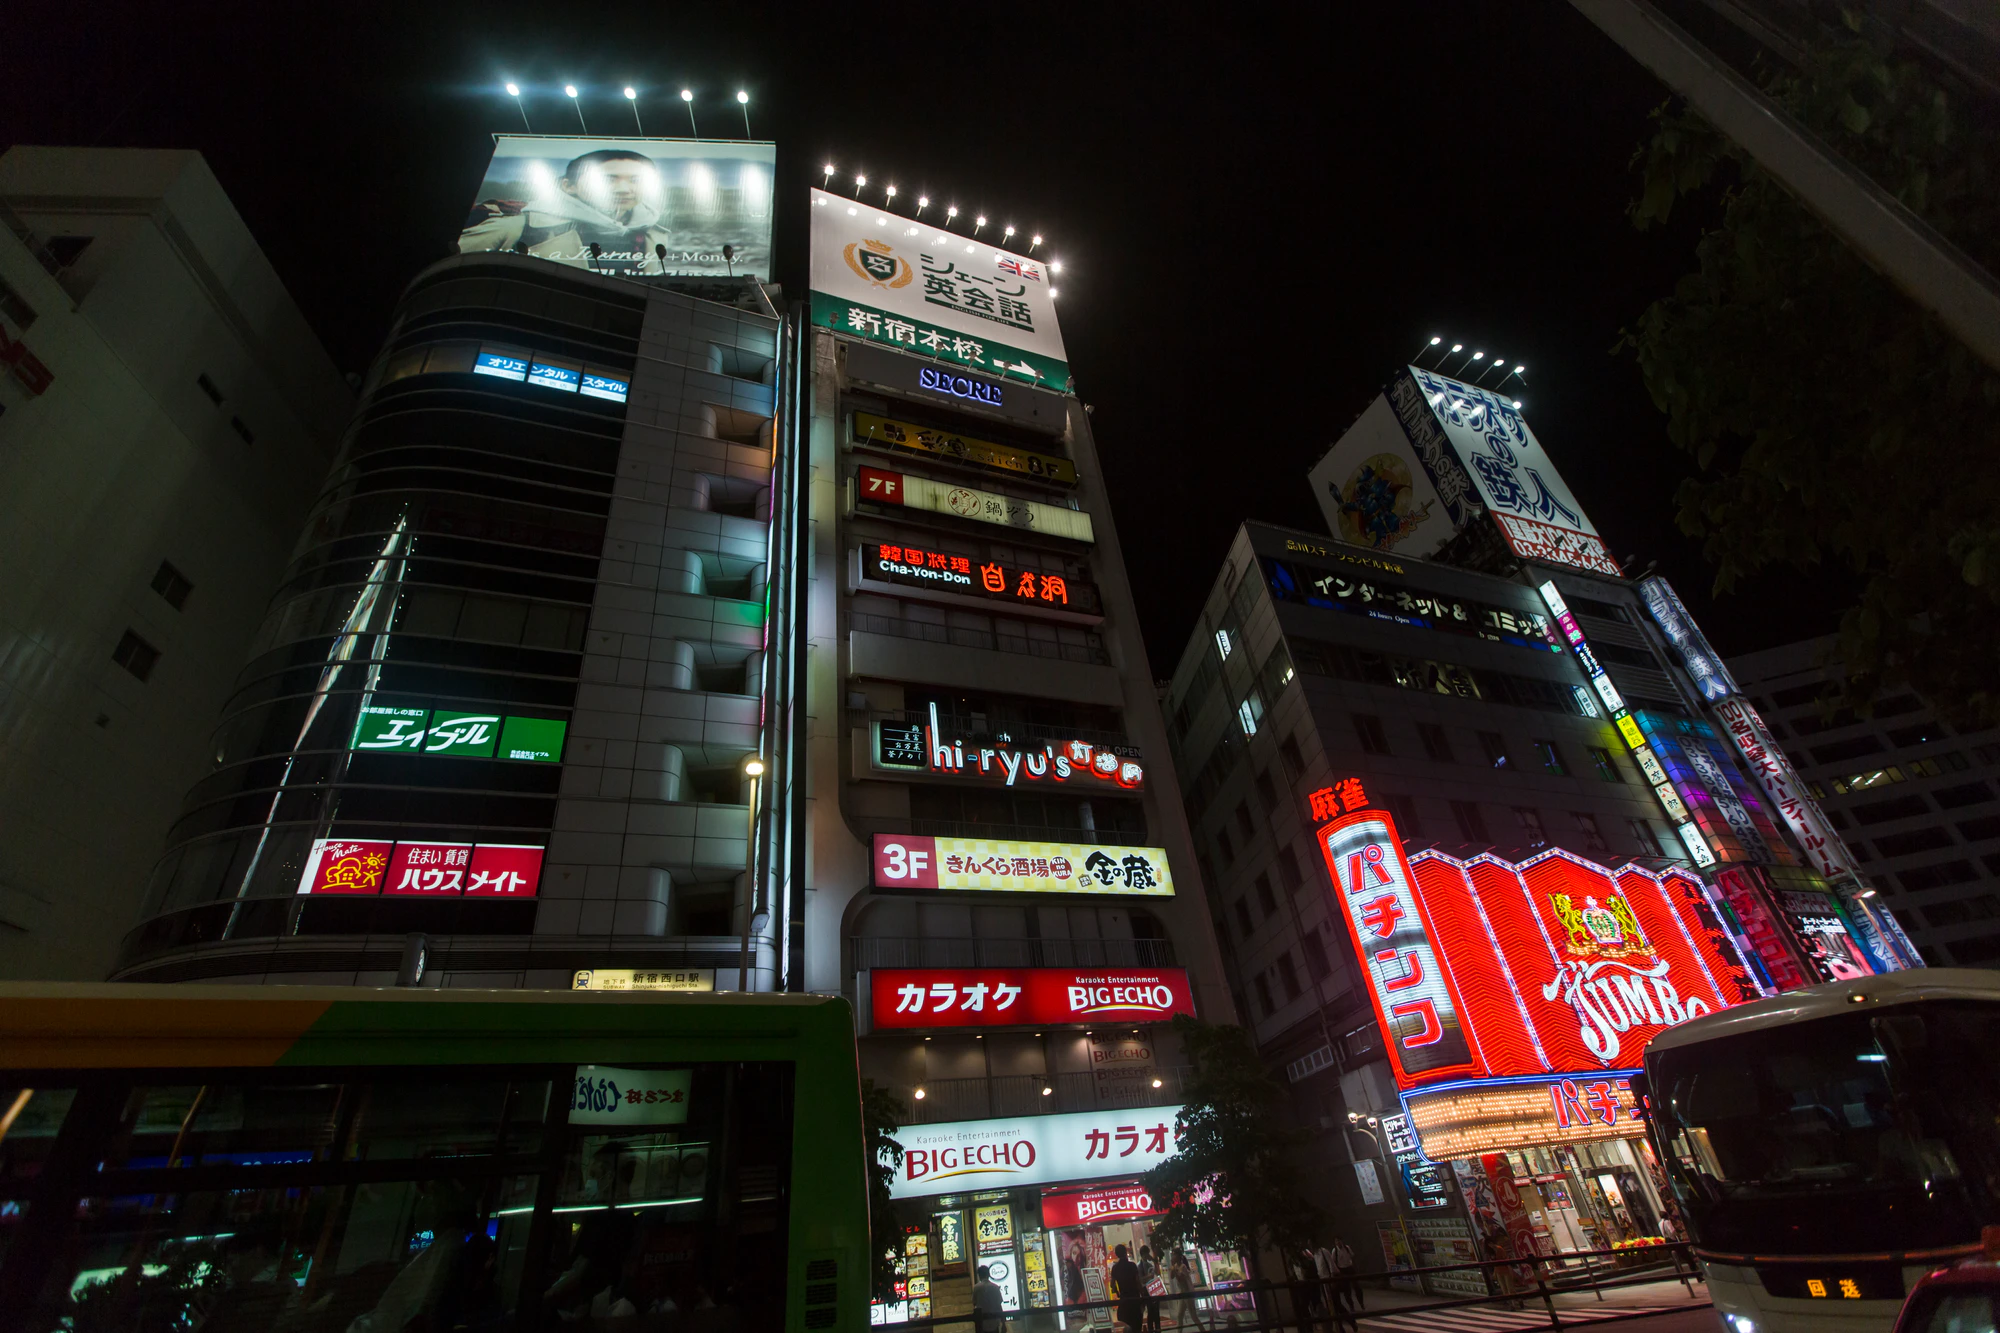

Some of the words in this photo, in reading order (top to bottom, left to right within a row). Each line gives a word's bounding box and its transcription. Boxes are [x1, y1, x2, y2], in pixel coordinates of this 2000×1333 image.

[920, 253, 1026, 297] シェーン
[923, 273, 1032, 325] 英会話
[848, 307, 986, 365] 新宿本校
[919, 367, 1003, 406] SECRE
[868, 477, 896, 495] 7F
[984, 500, 1034, 523] 鍋ぞう
[879, 543, 971, 574] 韓国料理
[879, 559, 971, 586] Cha-Yon-Don
[1615, 711, 1627, 720] 4F
[358, 716, 499, 751] エイブル
[929, 701, 1071, 786] hi-ryu's
[1307, 776, 1370, 823] 麻雀
[1716, 700, 1847, 880] 100名収容大パーティールーム
[331, 844, 363, 861] Mate
[407, 848, 441, 865] 住まい
[444, 849, 469, 866] 賃貸
[882, 843, 928, 879] 3F
[1051, 857, 1066, 865] KIN
[945, 854, 1050, 878] きんくら酒場
[1085, 850, 1156, 890] 金の蔵
[397, 868, 527, 892] ハウスメイト
[1347, 843, 1444, 1049] パチンコ
[632, 972, 699, 984] 新宿西口駅
[1075, 976, 1105, 984] Karaoke
[1107, 975, 1159, 984] Entertainment
[896, 982, 1021, 1013] カラオケ
[1068, 986, 1111, 1011] BIG
[1114, 985, 1173, 1009] ECHO
[1093, 1050, 1116, 1063] BIG
[1118, 1048, 1150, 1060] ECHO
[916, 1136, 954, 1144] Karaoke
[957, 1128, 1021, 1141] Entertainment
[1085, 1122, 1188, 1161] カラオ
[905, 1148, 957, 1181] BIG
[964, 1140, 1036, 1168] ECHO
[1105, 1187, 1143, 1197] Entertainment
[1077, 1200, 1108, 1220] BIG
[1110, 1194, 1152, 1212] ECHO
[979, 1217, 1009, 1237] 金の蔵
[1807, 1279, 1862, 1299] 回送
